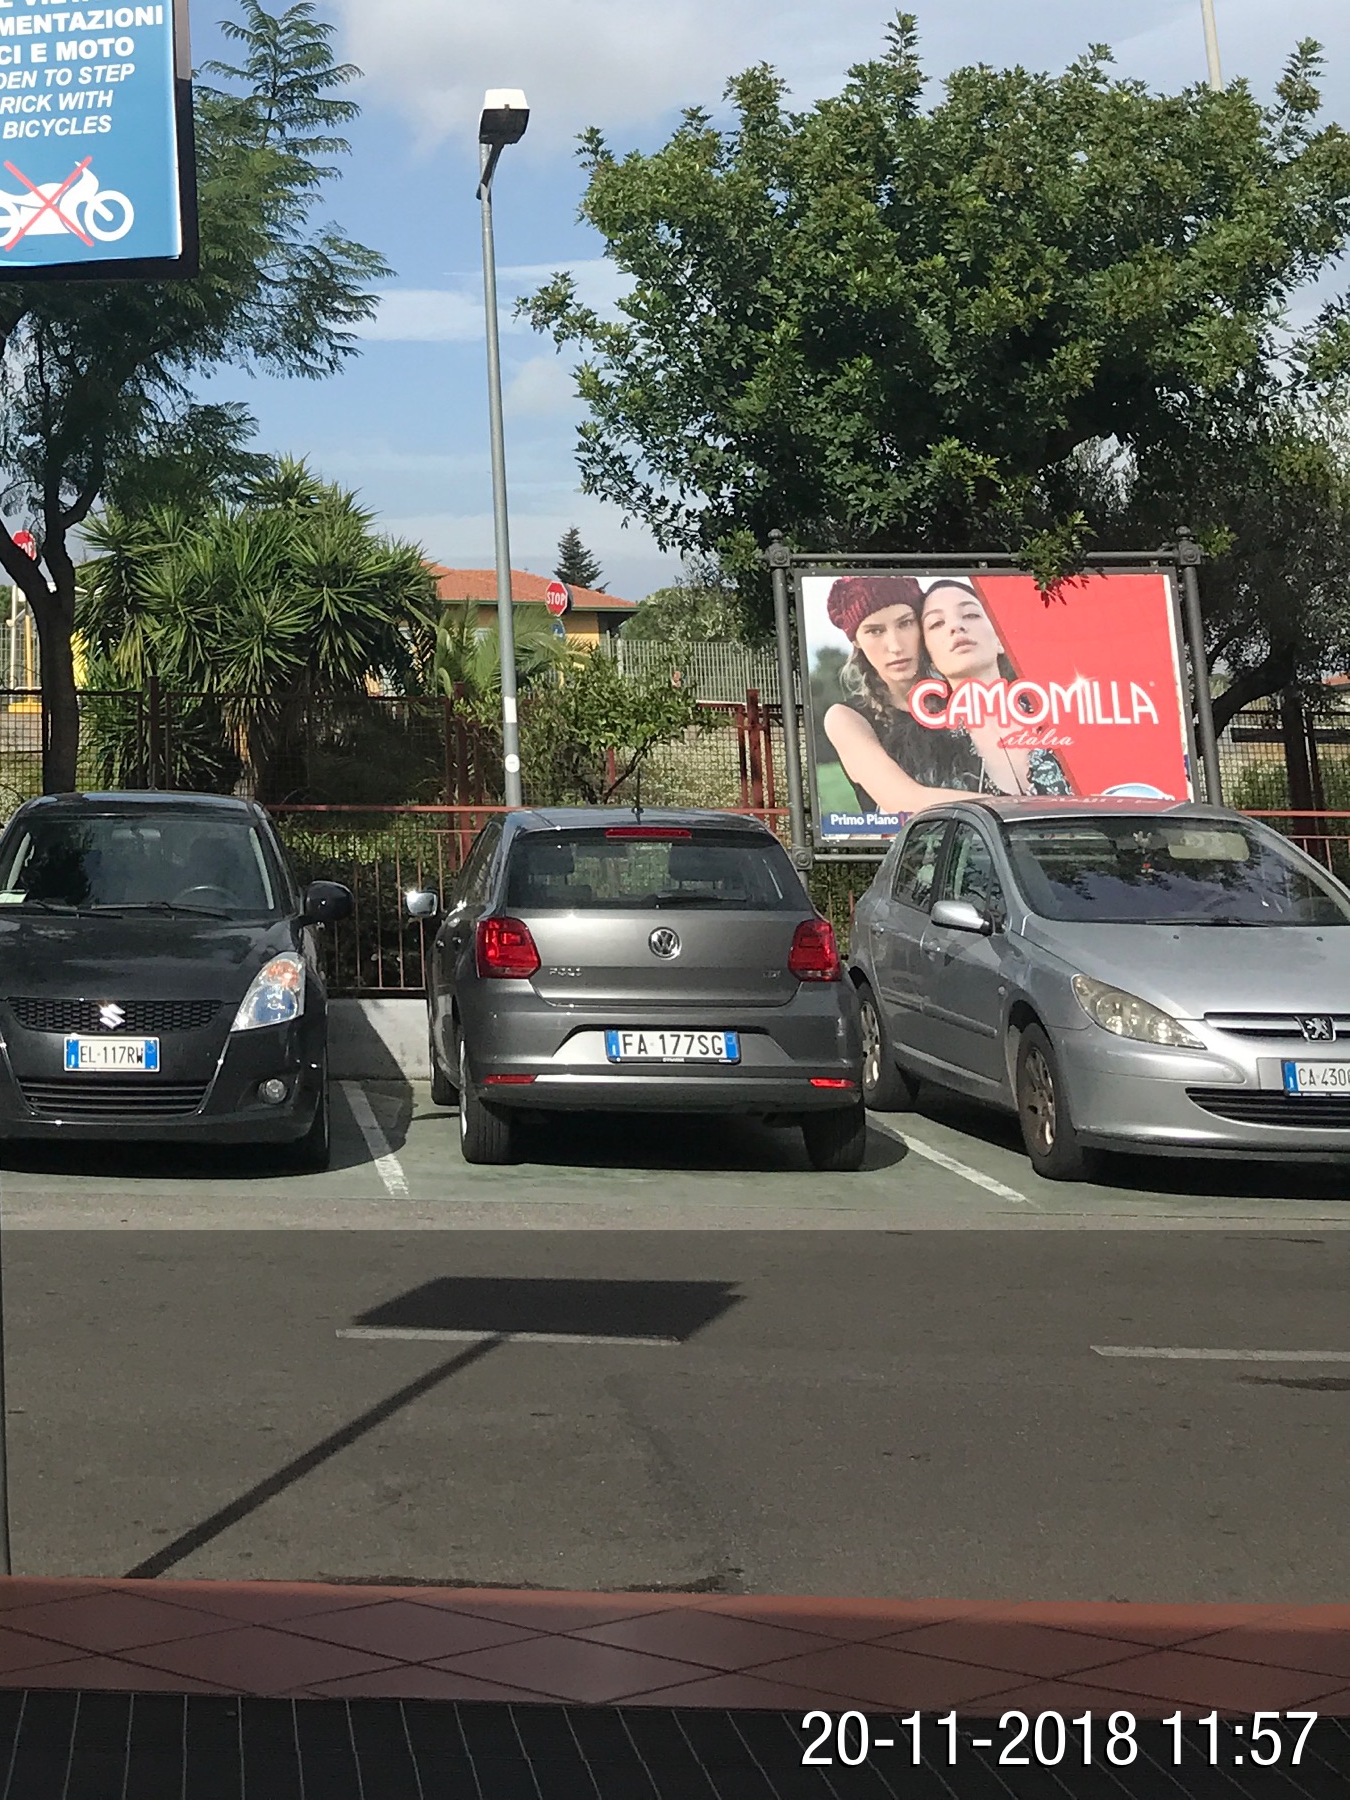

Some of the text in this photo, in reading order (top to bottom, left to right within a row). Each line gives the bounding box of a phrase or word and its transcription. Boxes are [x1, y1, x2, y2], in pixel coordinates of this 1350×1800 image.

[30, 42, 48, 63] E
[55, 37, 135, 61] MOTO
[43, 67, 75, 87] TO
[77, 63, 136, 85] STEP
[57, 90, 114, 111] WITH
[2, 115, 113, 139] BICYCLES
[547, 591, 566, 606] STOP
[911, 680, 1159, 725] CAMOMILLA
[830, 813, 899, 826] Primo Piano
